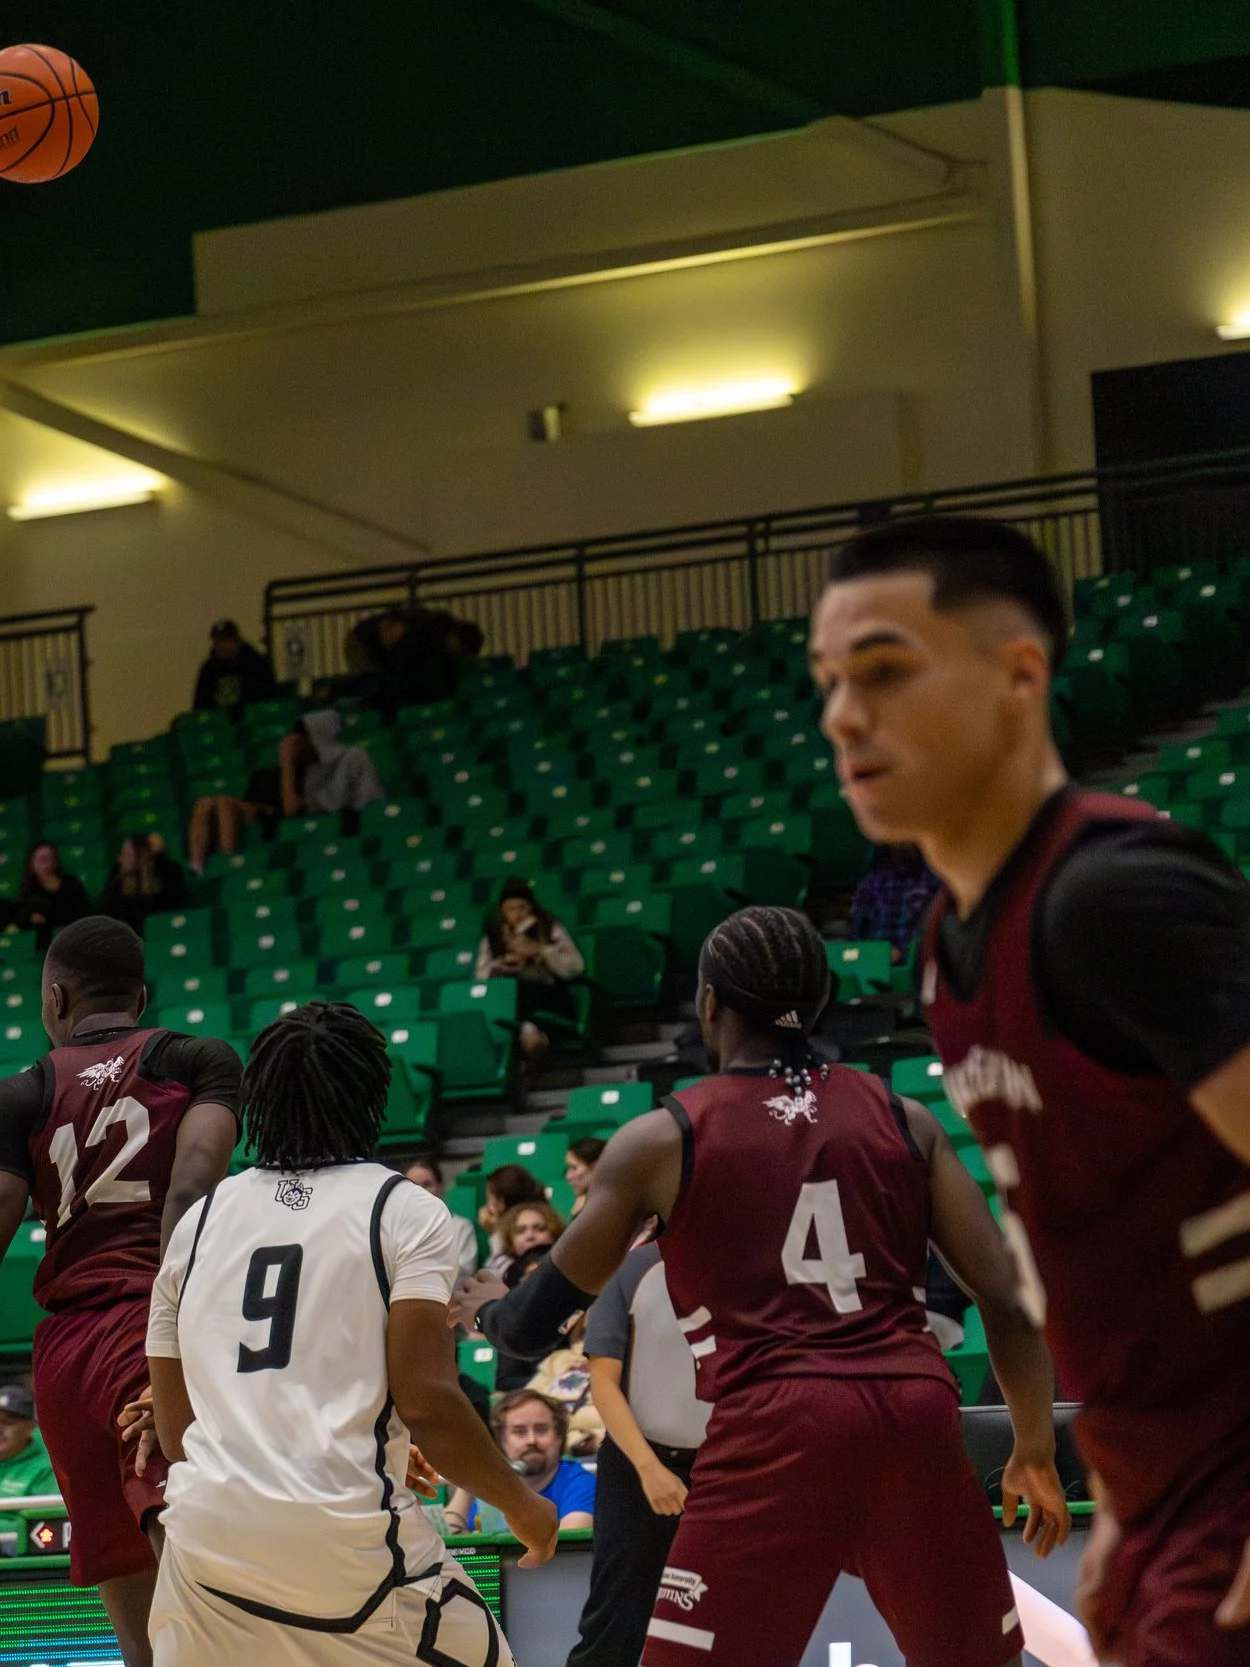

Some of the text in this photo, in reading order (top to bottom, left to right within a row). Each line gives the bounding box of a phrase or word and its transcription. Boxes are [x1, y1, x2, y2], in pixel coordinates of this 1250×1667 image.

[49, 1096, 151, 1228] 12
[236, 1243, 303, 1373] 9
[781, 1178, 867, 1314] 4
